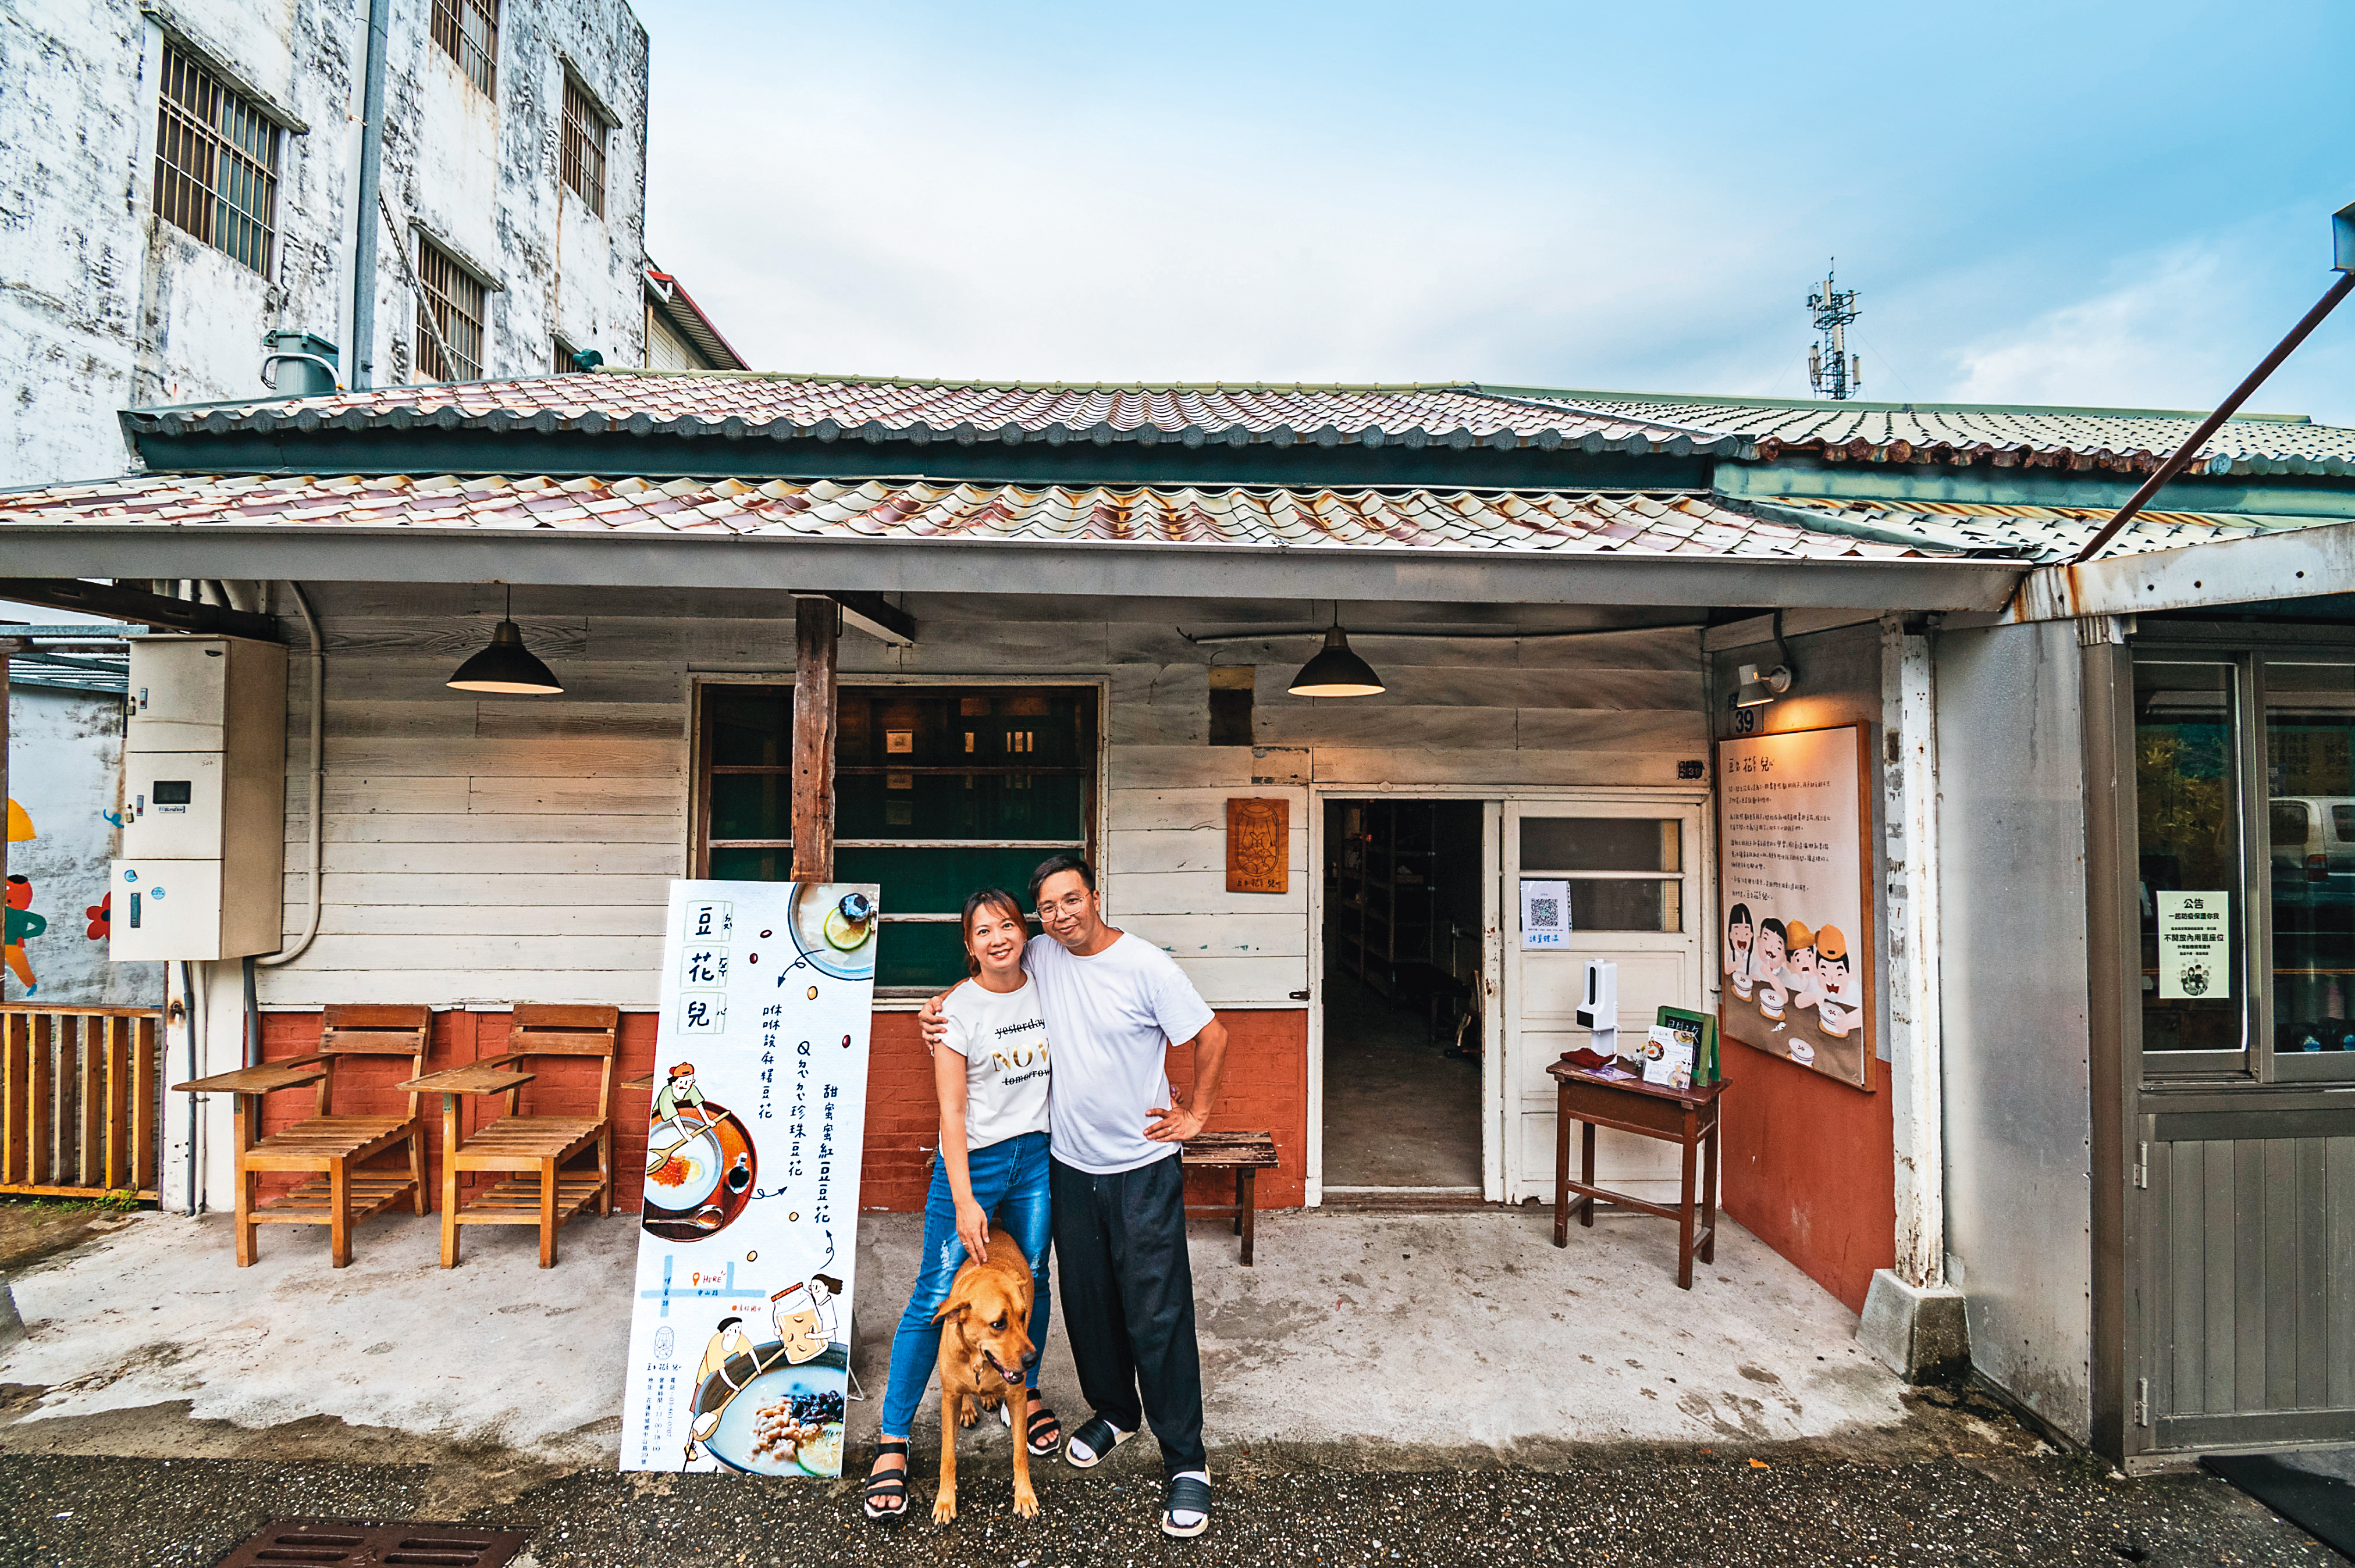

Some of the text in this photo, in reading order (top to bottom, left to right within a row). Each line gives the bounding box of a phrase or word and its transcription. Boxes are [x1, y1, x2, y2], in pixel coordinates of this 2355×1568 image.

[1735, 709, 1755, 733] 39
[2183, 898, 2204, 909] 公告
[2164, 933, 2224, 942] 不開放內用區座位
[688, 907, 714, 1028] 豆花兒
[994, 1018, 1045, 1039] yesterday
[1002, 1068, 1051, 1086] tomorrow
[814, 1084, 838, 1224] 甜蜜蜜紅豆豆花
